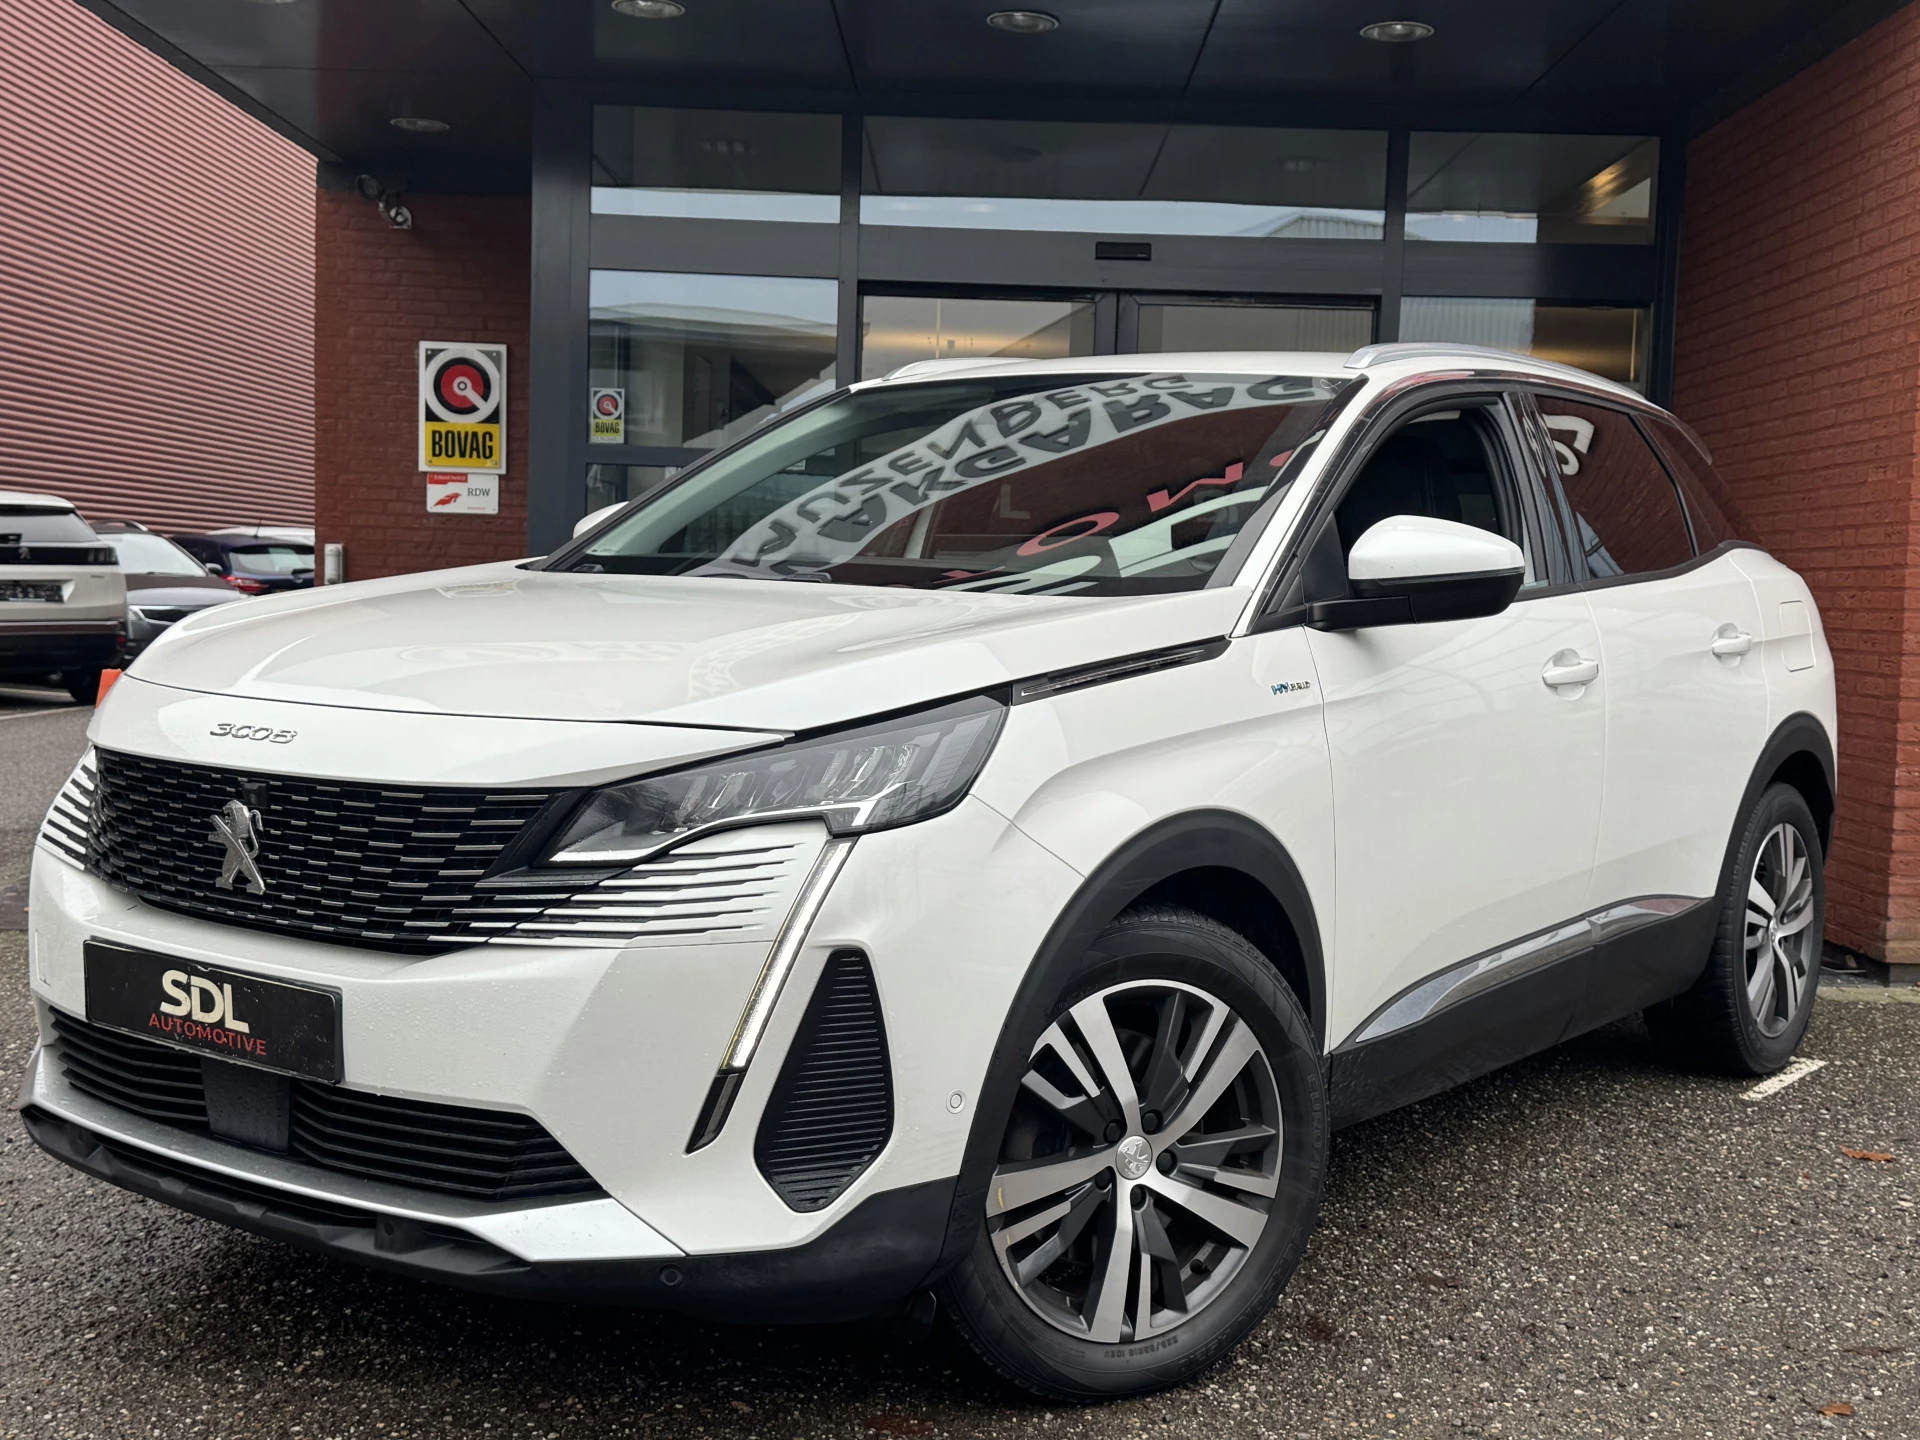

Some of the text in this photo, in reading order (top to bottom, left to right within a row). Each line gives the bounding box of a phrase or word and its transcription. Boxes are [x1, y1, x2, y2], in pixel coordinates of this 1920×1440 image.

[594, 421, 620, 434] BOVAG
[431, 429, 494, 459] BOVAG
[467, 487, 491, 497] RDW
[209, 722, 299, 744] 3008
[159, 969, 250, 1034] SDL
[148, 1012, 268, 1056] AUTOMOTIVE
